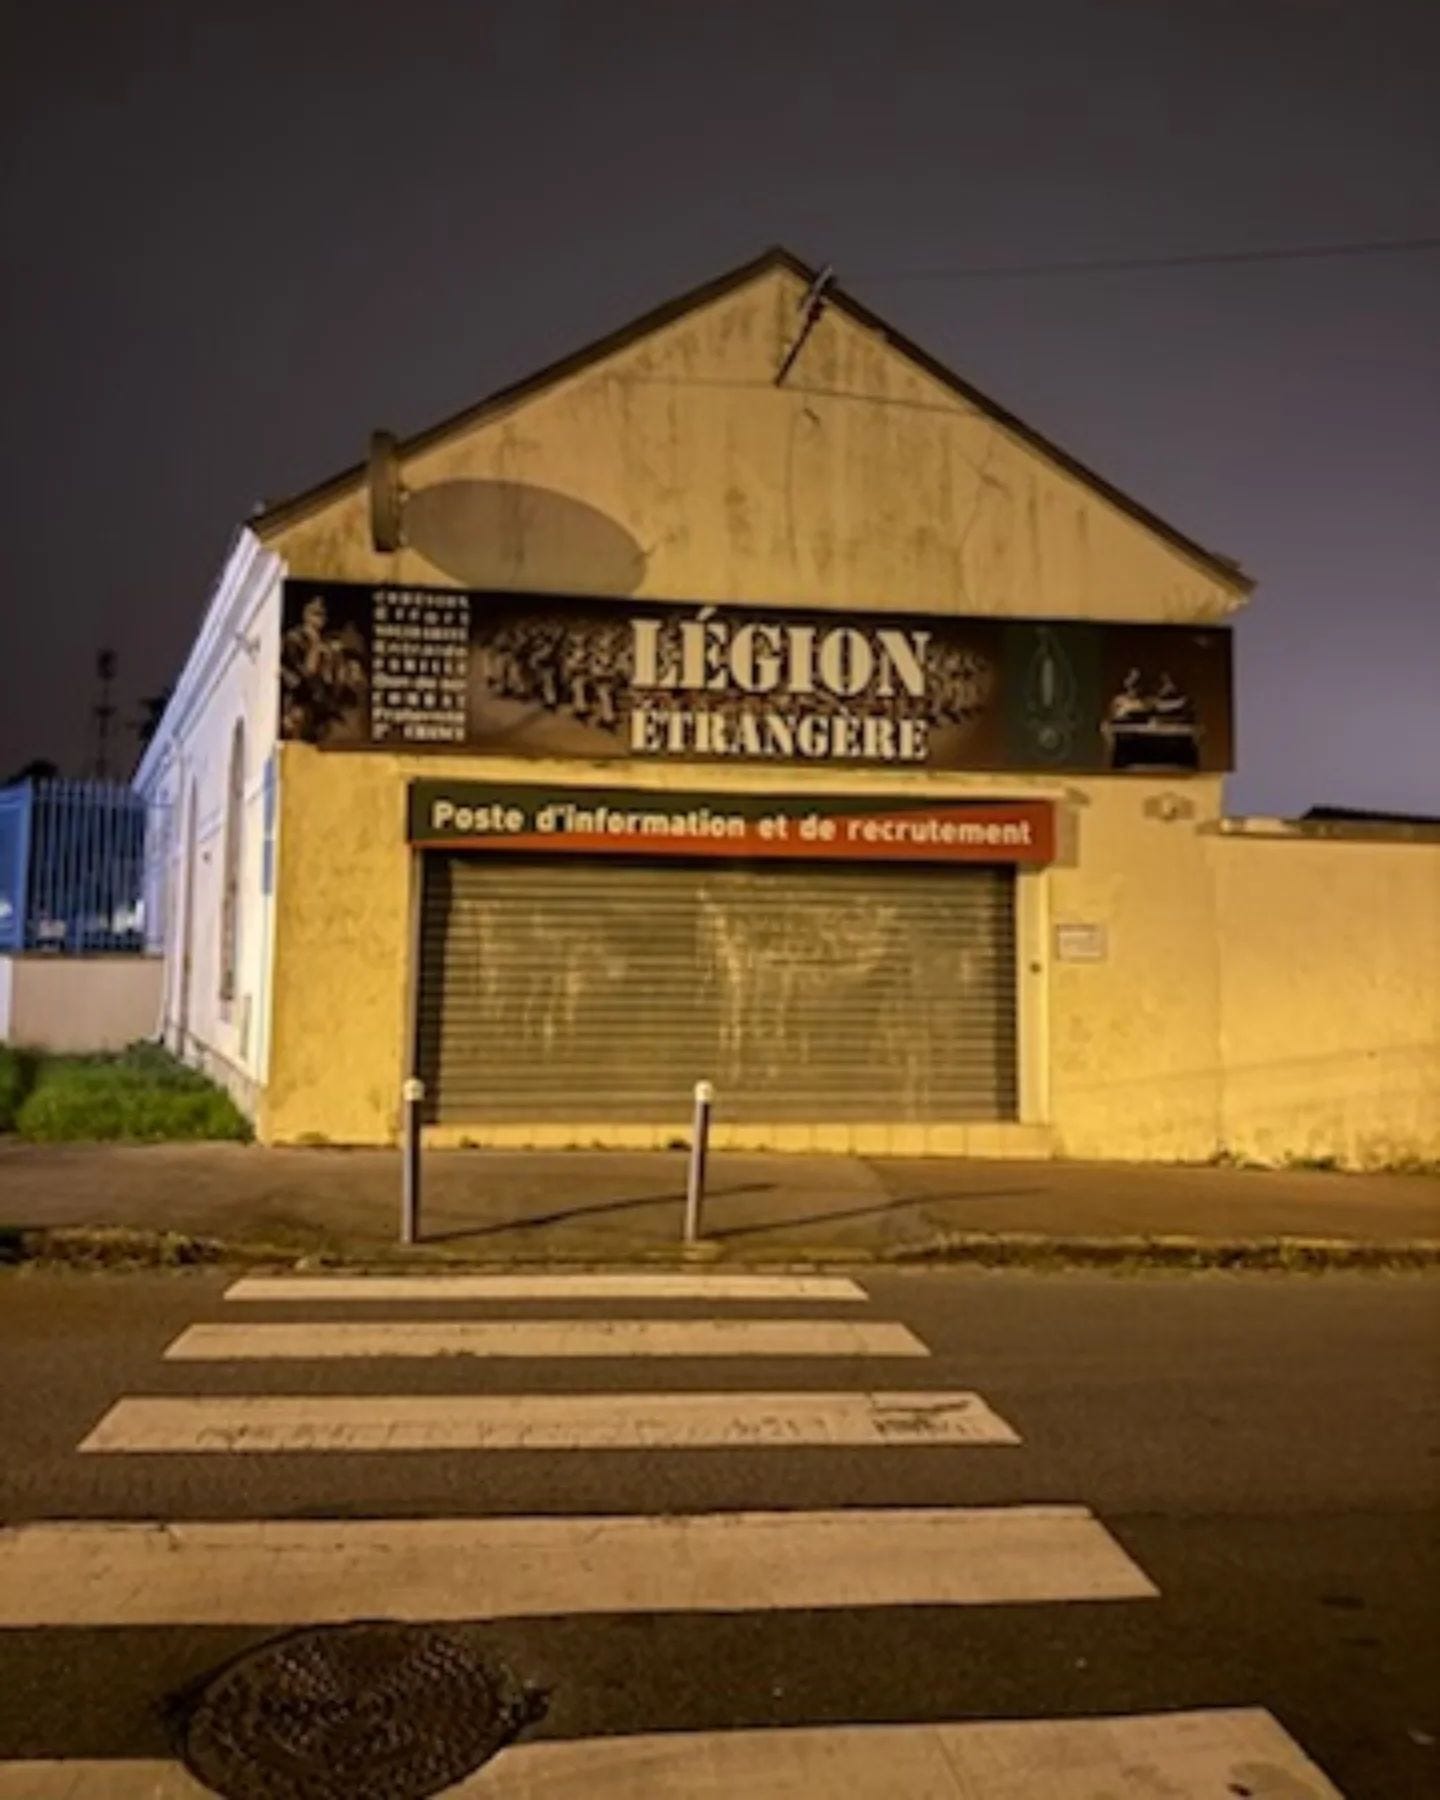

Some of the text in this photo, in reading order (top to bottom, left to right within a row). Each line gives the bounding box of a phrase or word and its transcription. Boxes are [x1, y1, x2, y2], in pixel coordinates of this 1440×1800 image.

[630, 607, 931, 697] LÉGION
[432, 800, 1032, 846] Poste d'information et de recrutement
